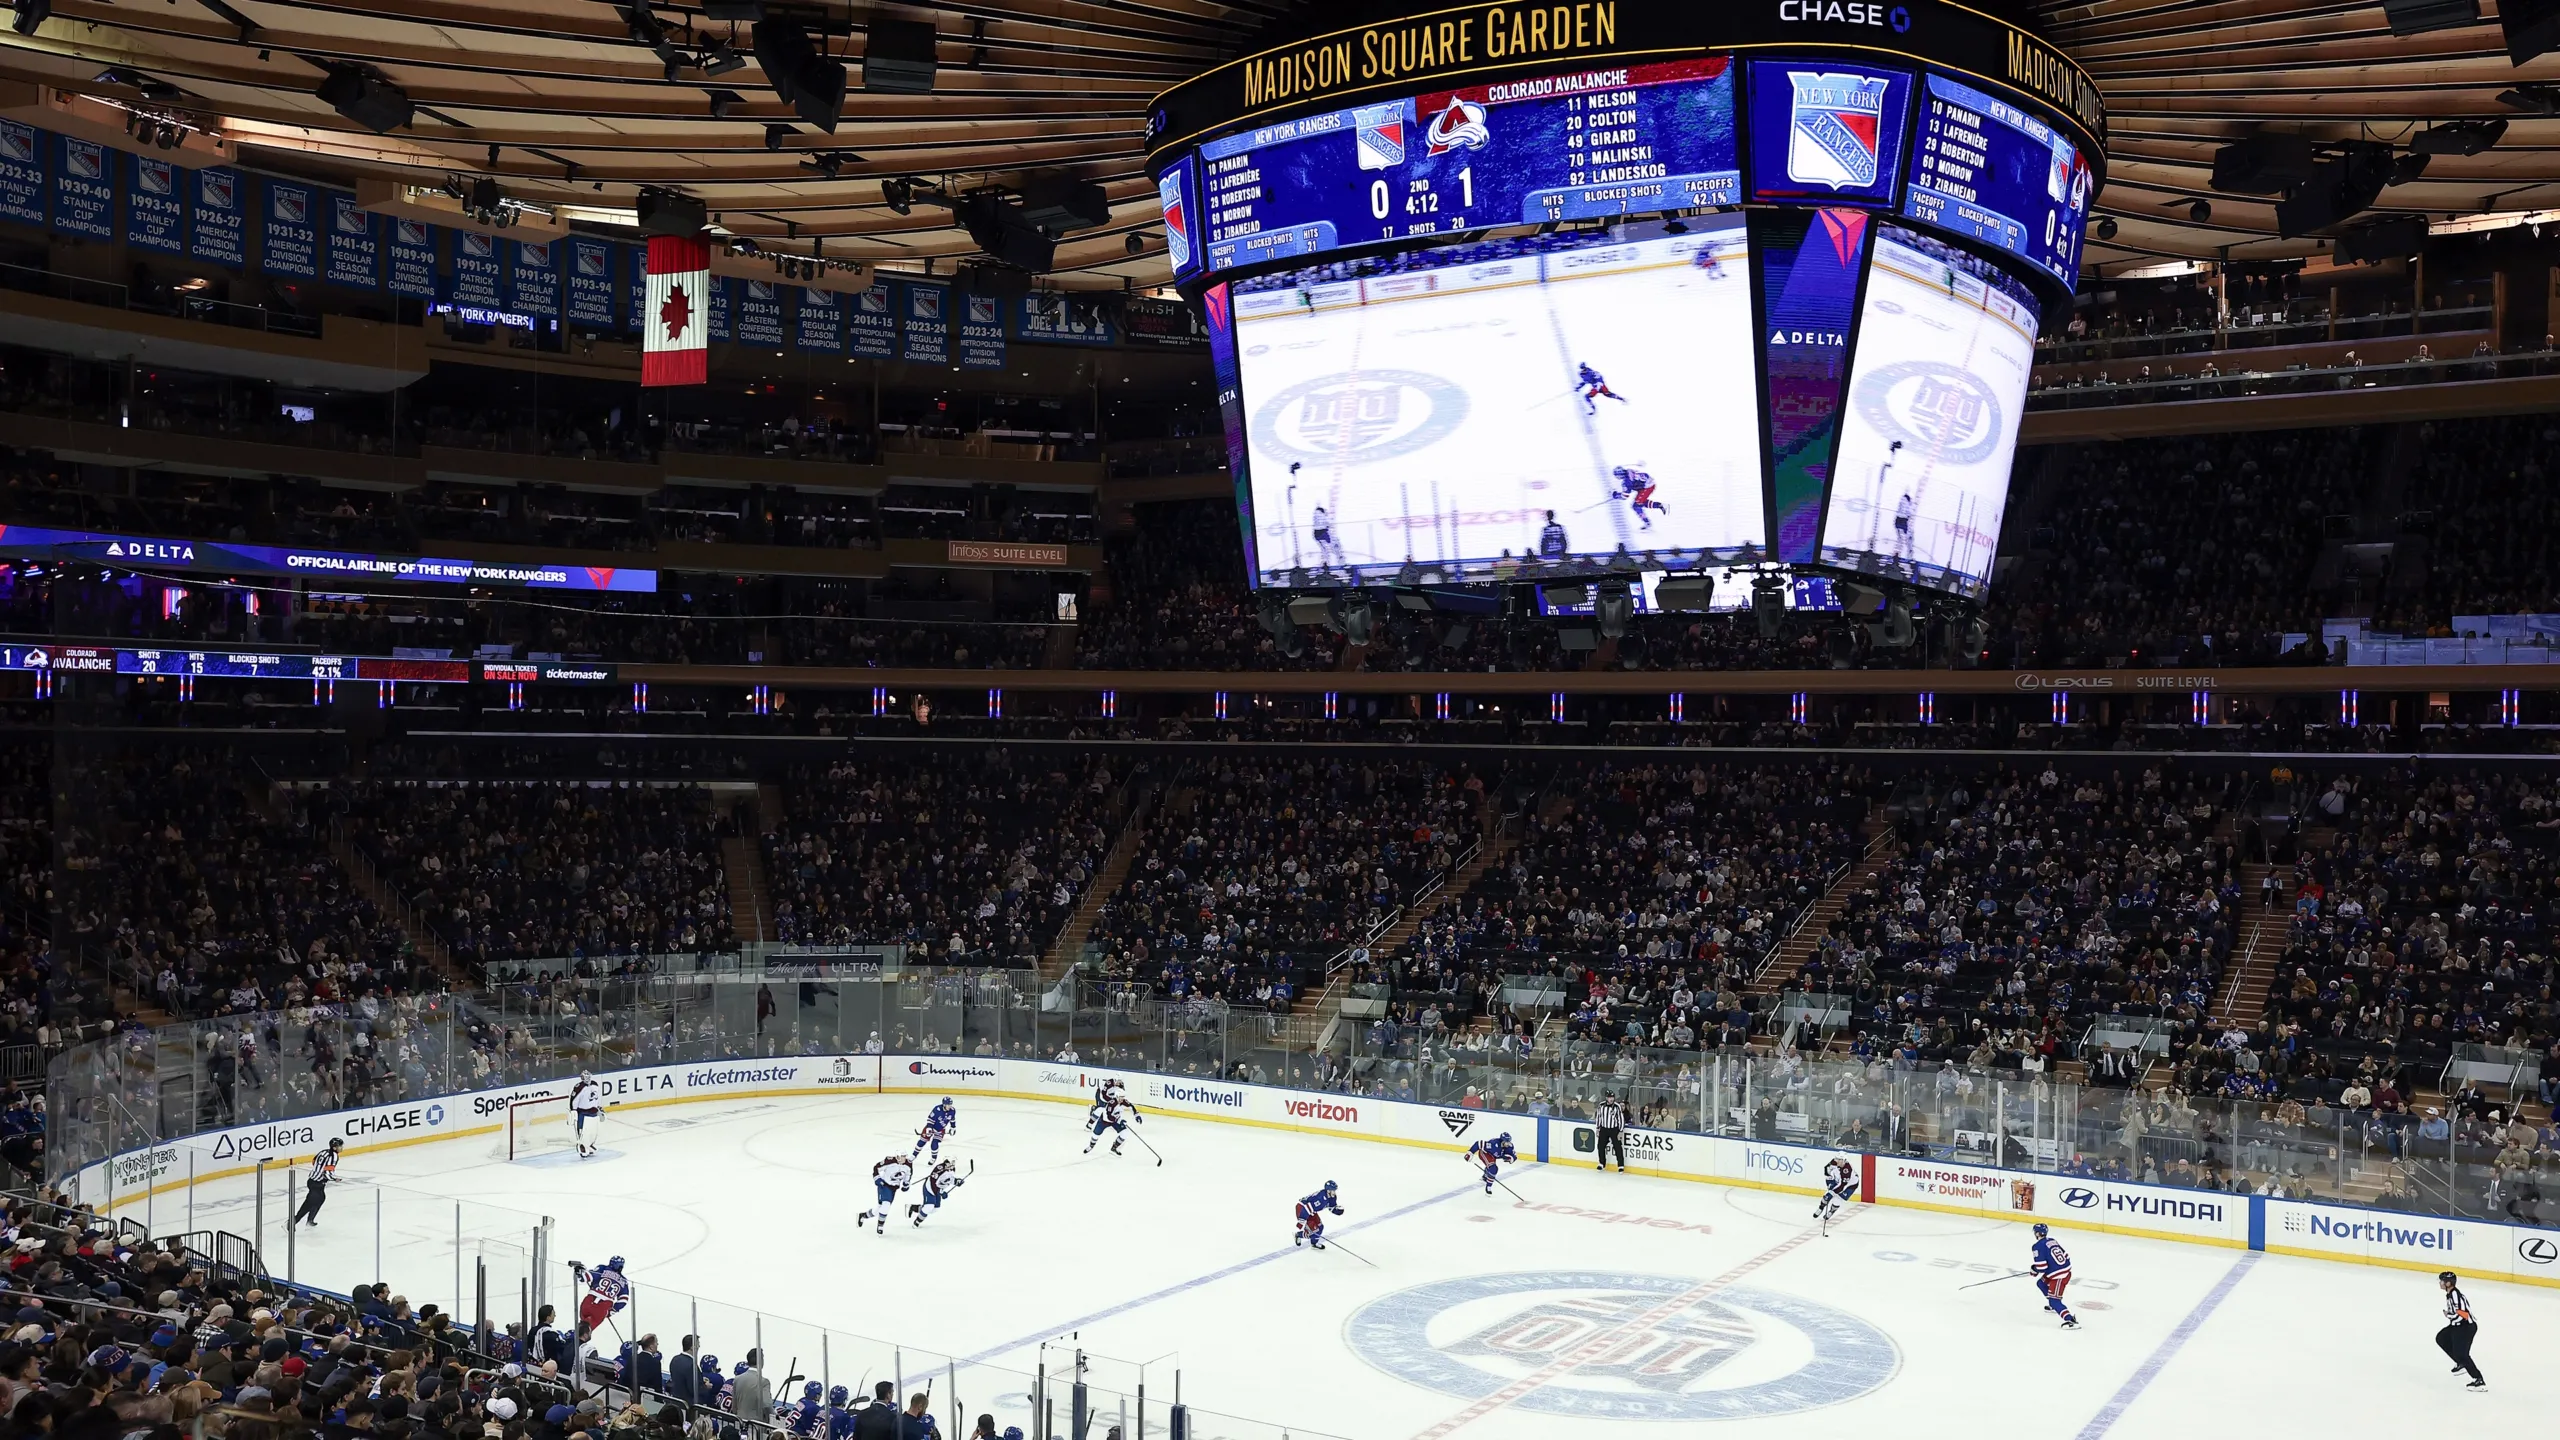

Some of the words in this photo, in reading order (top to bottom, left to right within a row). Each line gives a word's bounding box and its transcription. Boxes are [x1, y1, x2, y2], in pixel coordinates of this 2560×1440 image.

[1780, 0, 1883, 26] CHASE
[1244, 41, 1351, 108] MADISON
[1362, 19, 1473, 78] SQUARE
[1487, 1, 1615, 58] GARDEN
[2008, 30, 2072, 108] MADISON
[1489, 79, 1552, 101] COLORADO
[1555, 70, 1627, 91] AVALANCHE
[1567, 98, 1581, 111] 11
[1588, 91, 1636, 109] NELSON
[1798, 88, 1836, 105] NEW
[1843, 90, 1878, 109] YORK
[1359, 115, 1375, 127] NEW
[1378, 112, 1400, 123] YORK
[1567, 116, 1582, 130] 20
[1589, 110, 1636, 127] COLTON
[1932, 100, 1942, 114] 10
[1946, 106, 1980, 129] PANARIN
[1991, 101, 2005, 119] NEW
[2006, 106, 2023, 126] YORK
[2024, 115, 2049, 142] RANGERS
[1255, 131, 1273, 145] NEW
[1274, 127, 1296, 139] YORK
[1300, 114, 1340, 134] RANGERS
[1366, 131, 1401, 160] RANGERS
[1568, 135, 1583, 148] 49
[1591, 129, 1636, 146] GIRARD
[1812, 115, 1873, 180] RANGERS
[1569, 154, 1584, 167] 70
[1592, 146, 1651, 165] MALINSKI
[1208, 164, 1216, 176] 10
[1219, 155, 1248, 173] PANARIN
[1210, 180, 1218, 192] 13
[1221, 169, 1260, 189] LAFRENIÈRE
[1570, 172, 1585, 186] 92
[1593, 164, 1666, 183] LANDESKOG
[58, 178, 111, 199] 1939-40
[1410, 179, 1429, 193] 2ND
[1459, 167, 1472, 207] 1
[1584, 188, 1627, 202] BLOCKED
[1631, 185, 1662, 197] SHOTS
[1685, 178, 1733, 192] FACEOFFS
[1920, 173, 1931, 187] 93
[1935, 177, 1976, 202] ZIBANEJAD
[63, 196, 104, 212] STANLEY
[1211, 197, 1219, 208] 29
[1222, 186, 1261, 205] ROBERTSON
[1371, 180, 1389, 219] 0
[1406, 193, 1438, 215] 4:12
[1543, 194, 1564, 207] HITS
[1693, 192, 1726, 205] 42.1%
[75, 209, 93, 221] CUP
[1212, 213, 1220, 225] 60
[1223, 205, 1252, 222] MORROW
[1548, 208, 1561, 220] 15
[1620, 201, 1627, 213] 7
[56, 217, 111, 236] CHAMPIONS
[195, 208, 241, 228] 1926-27
[195, 224, 239, 241] AMERICAN
[1213, 229, 1221, 241] 93
[1225, 221, 1260, 238] ZIBANEJAD
[1303, 228, 1318, 239] HITS
[1383, 227, 1393, 238] 17
[1409, 223, 1435, 235] SHOTS
[1452, 217, 1464, 229] 20
[2045, 209, 2055, 246] 0
[200, 235, 236, 251] DIVISION
[330, 235, 375, 253] 1941-42
[1247, 238, 1272, 250] BLOCKED
[1273, 233, 1293, 243] SHOTS
[1308, 241, 1316, 252] 21
[192, 244, 242, 263] CHAMPIONS
[332, 250, 372, 265] REGULAR
[1212, 244, 1235, 258] FACEOFFS
[1267, 249, 1274, 258] 11
[336, 261, 369, 275] SEASON
[456, 257, 499, 275] 1991-92
[1216, 259, 1232, 269] 57.9%
[328, 270, 376, 286] CHAMPIONS
[460, 273, 494, 285] PATRICK
[570, 276, 612, 293] 1993-94
[460, 283, 494, 295] DIVISION
[453, 292, 500, 306] CHAMPIONS
[573, 292, 609, 304] ATLANTIC
[437, 305, 451, 313] NE
[460, 308, 485, 321] YORK
[487, 311, 529, 326] RANGERS
[575, 301, 607, 313] DIVISION
[568, 309, 612, 323] CHAMPIONS
[905, 321, 947, 333] 2023-24
[909, 334, 943, 344] REGULAR
[1792, 332, 1843, 346] DELTA
[911, 343, 940, 353] SEASON
[905, 352, 947, 362] CHAMPIONS
[129, 543, 194, 559] DELTA
[952, 543, 988, 559] Infosys
[994, 548, 1026, 559] SUITE
[1029, 549, 1062, 561] LEVEL
[287, 555, 346, 570] OFFICIAL
[348, 560, 396, 573] AIRLINE
[398, 563, 416, 574] OF
[417, 564, 442, 576] THE
[443, 566, 472, 577] NEW
[473, 567, 507, 579] YORK
[509, 570, 566, 582] RANGERS
[5, 650, 10, 665] 1
[66, 649, 97, 657] COLORADO
[138, 651, 160, 660] SHOTS
[189, 653, 204, 661] HITS
[229, 655, 258, 663] BLOCKED
[259, 656, 279, 664] SHOTS
[312, 657, 342, 666] FACEOFFS
[53, 657, 112, 670] AVALANCHE
[143, 661, 156, 673] 20
[191, 662, 203, 674] 15
[251, 664, 258, 676] 7
[312, 666, 341, 678] 42.1%
[497, 672, 516, 680] SALE
[518, 672, 537, 680] NOW
[546, 669, 607, 679] ticketmaster
[2042, 676, 2113, 688] LEXUS
[2137, 677, 2174, 688] SUITE
[2178, 676, 2218, 688] LEVEL
[832, 963, 878, 973] ULTRA
[687, 1065, 798, 1087] ticketmaster
[909, 1061, 996, 1083] Champion
[602, 1074, 674, 1096] DELTA
[1164, 1084, 1242, 1107] Northwell
[1285, 1099, 1358, 1123] verizon
[1439, 1110, 1475, 1120] GAME
[345, 1109, 421, 1136] CHASE
[238, 1126, 313, 1161] pellera
[1746, 1148, 1804, 1175] Infosys
[1899, 1167, 1905, 1177] 2
[1908, 1169, 1931, 1179] MIN
[1935, 1171, 1958, 1182] FOR
[1962, 1175, 2004, 1188] SIPPIN'
[1939, 1184, 1986, 1198] DUNKIN'
[2108, 1193, 2222, 1222] HYUNDAI
[2311, 1215, 2452, 1250] Northwell
[597, 1277, 620, 1297] 93
